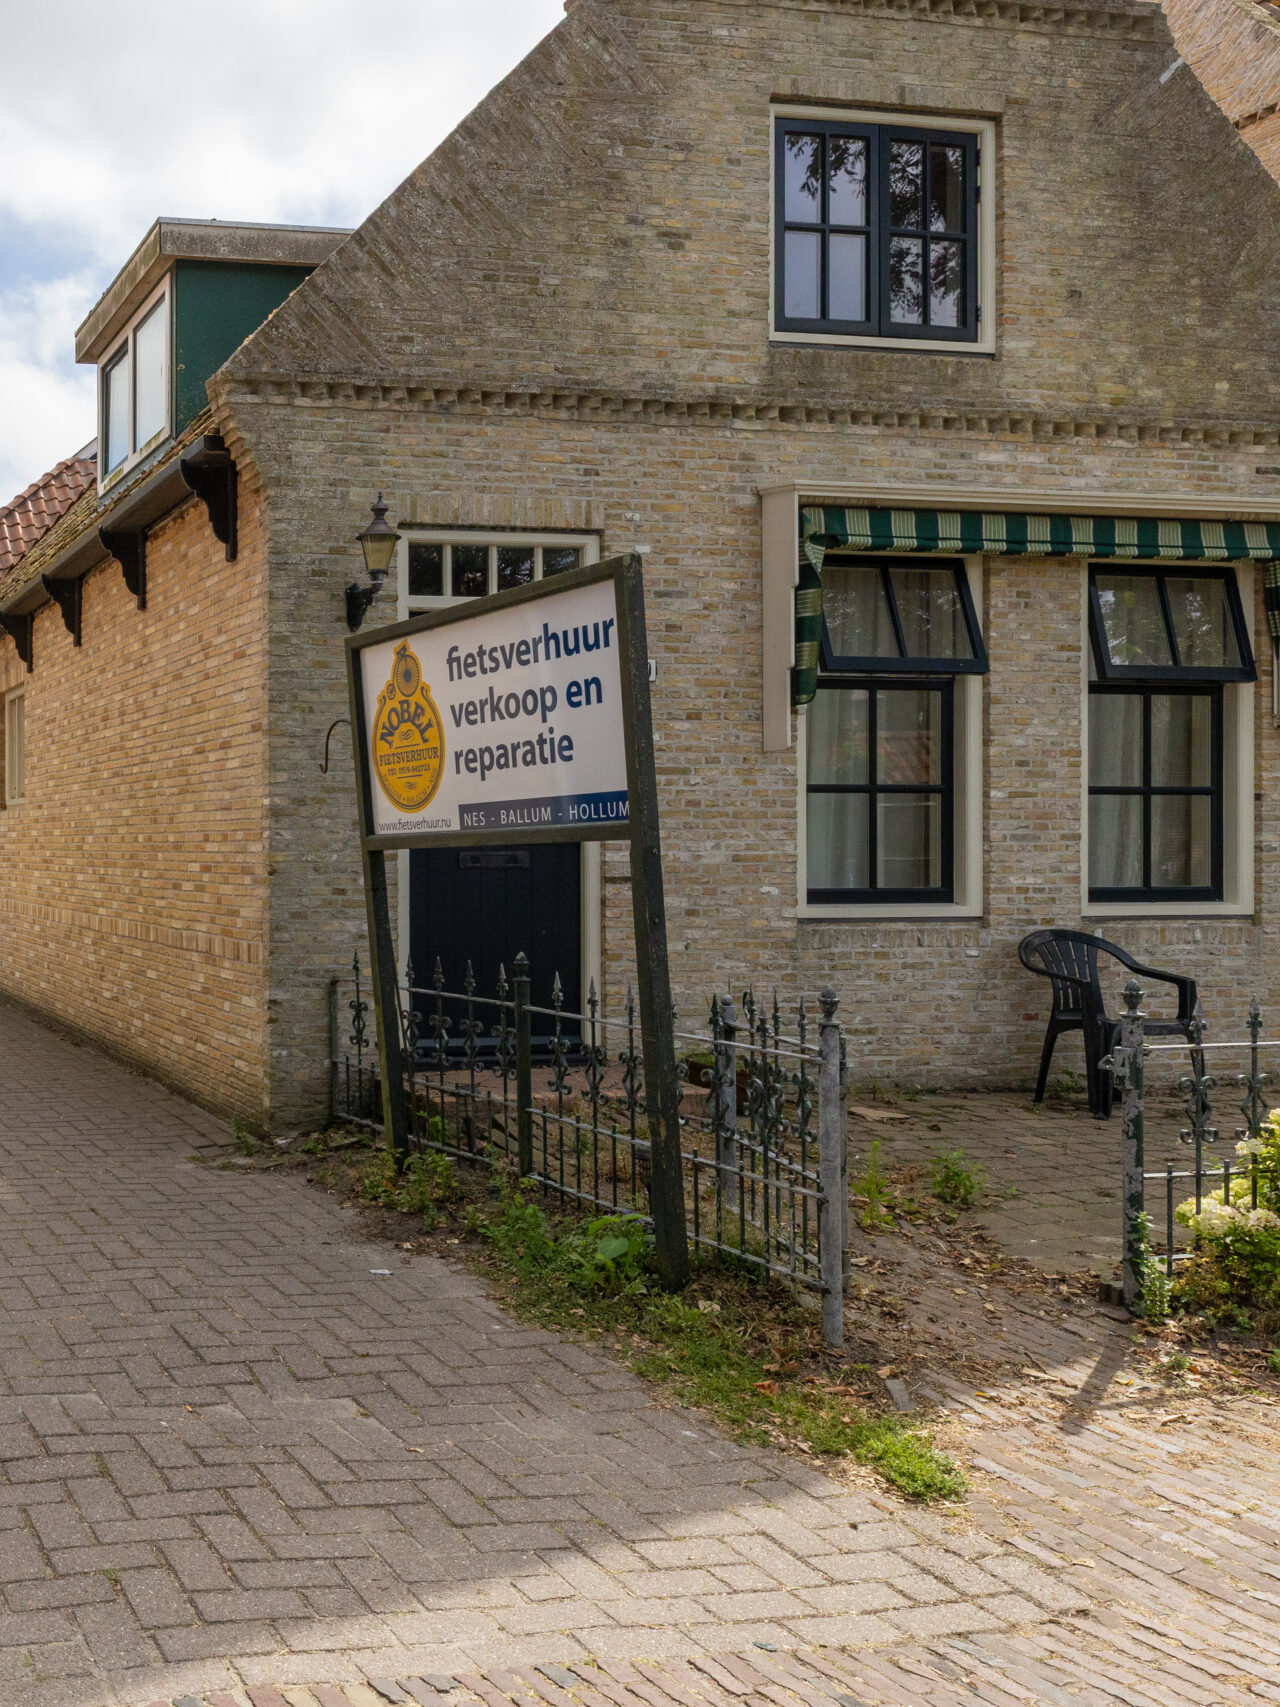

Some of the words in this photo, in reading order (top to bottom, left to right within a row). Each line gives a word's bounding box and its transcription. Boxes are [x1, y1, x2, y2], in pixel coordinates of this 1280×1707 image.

[446, 617, 615, 682] fietsverhuur
[379, 699, 434, 749] NOBEL
[450, 686, 558, 728] verkoop
[566, 676, 603, 708] en
[379, 746, 440, 767] FIETSVERHUUR
[454, 725, 574, 781] reparatie
[379, 816, 452, 832] www.fietsverhuur.nu
[464, 811, 486, 827] NES
[500, 806, 552, 825] BALLUM
[569, 800, 630, 820] HOLLUM
